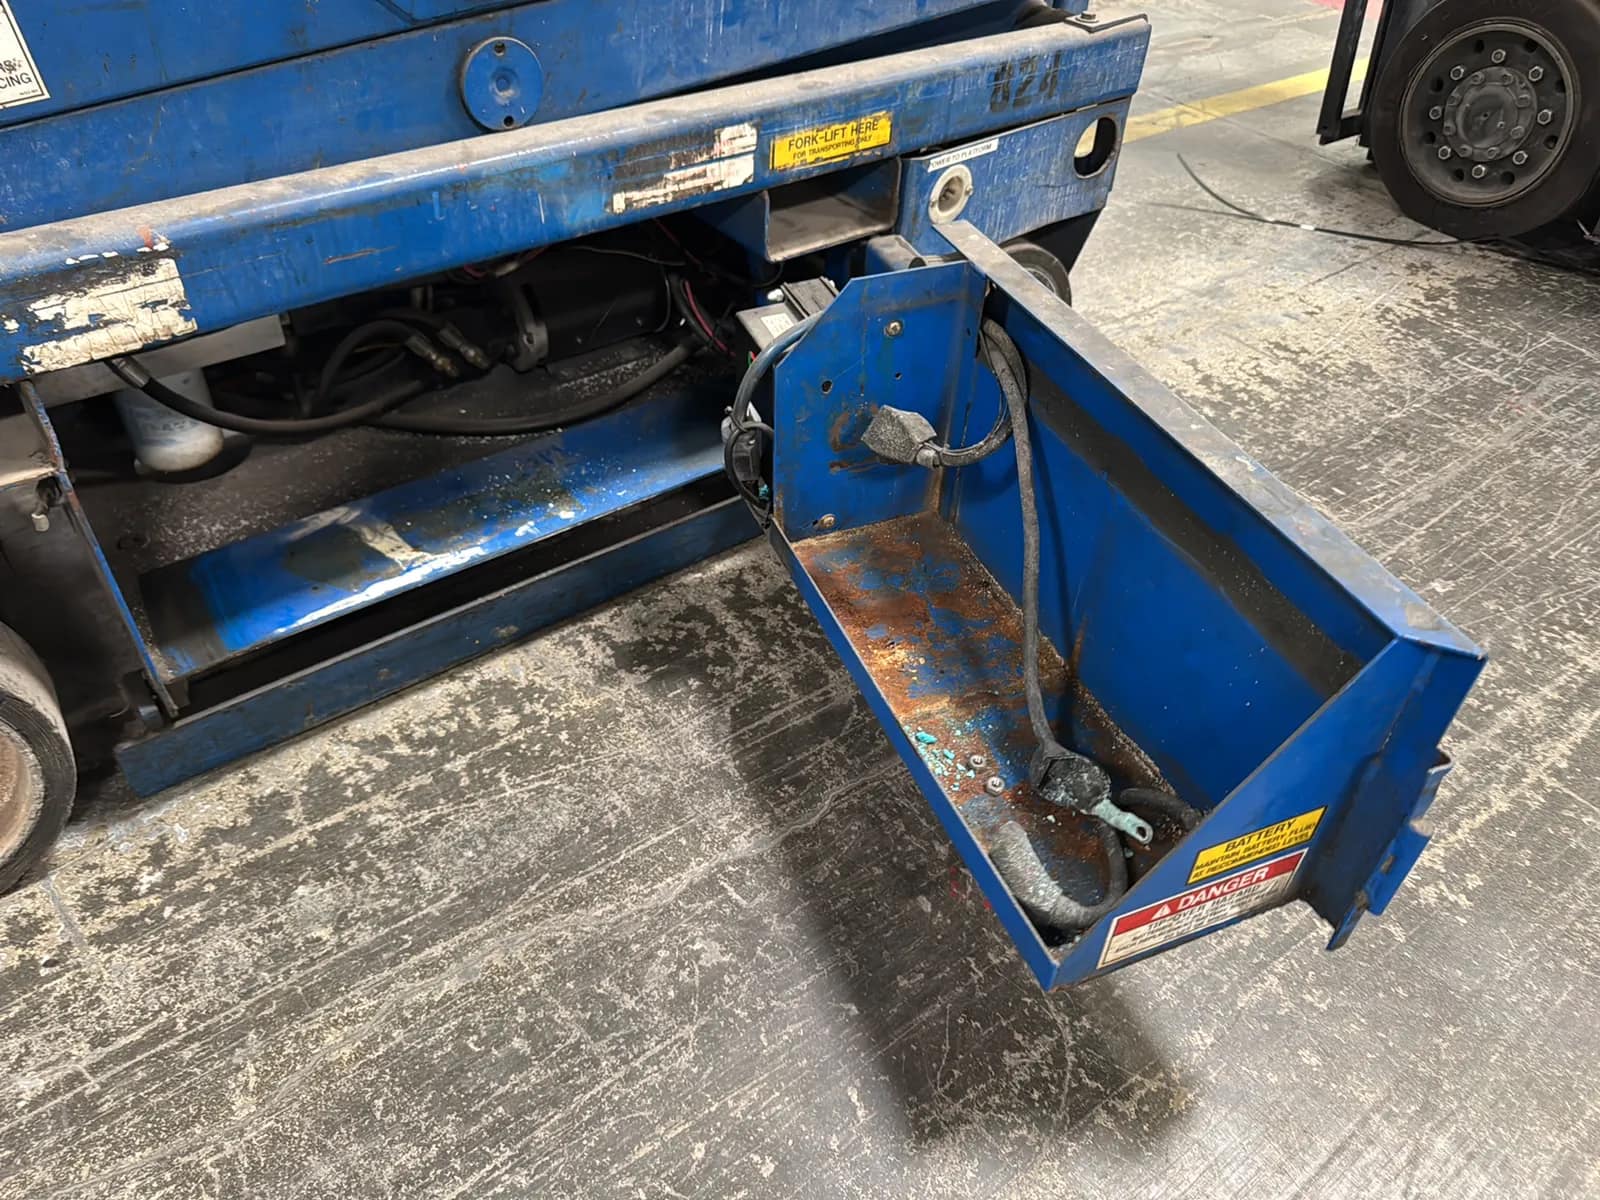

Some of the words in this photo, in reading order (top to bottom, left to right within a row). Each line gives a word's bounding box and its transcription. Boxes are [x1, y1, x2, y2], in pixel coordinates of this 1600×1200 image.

[788, 127, 847, 152] FORK-LIFT
[851, 120, 879, 136] HERE
[1224, 819, 1296, 852] BATTERY
[1176, 865, 1271, 911] DANGER
